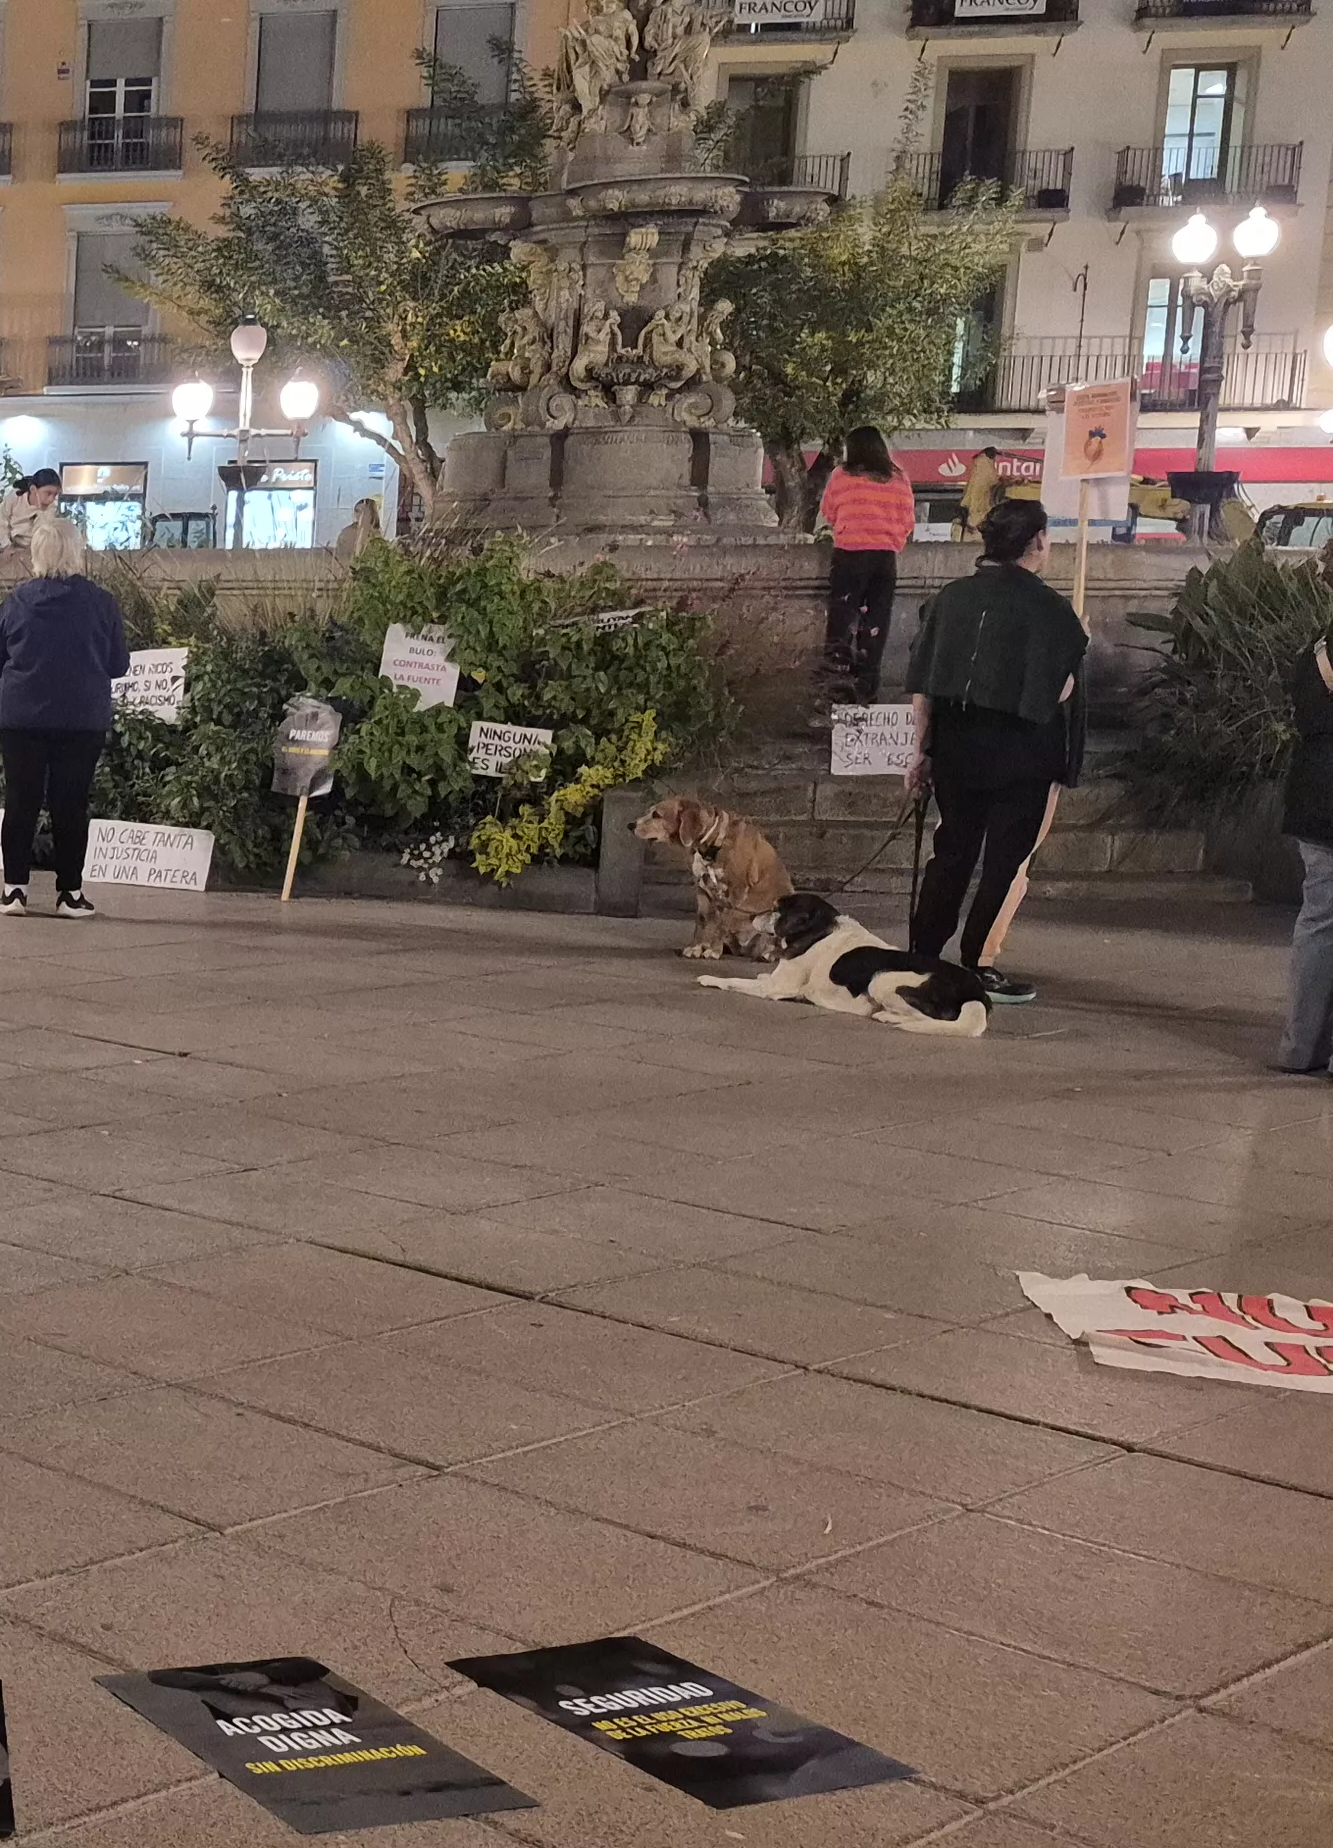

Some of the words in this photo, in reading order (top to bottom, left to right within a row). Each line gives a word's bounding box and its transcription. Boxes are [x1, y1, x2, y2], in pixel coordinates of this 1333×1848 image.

[738, 0, 819, 17] FRANCOY
[271, 467, 313, 482] Prieto
[148, 661, 174, 675] RICOS
[392, 658, 448, 673] CONTRASTA
[143, 680, 152, 692] SI
[394, 673, 405, 681] LA
[407, 674, 442, 686] FUENTE
[844, 711, 899, 728] DERECHO
[288, 728, 330, 743] PAREMOS
[471, 756, 490, 771] ES
[844, 750, 872, 769] SER
[96, 826, 116, 843] NO
[118, 828, 150, 846] CABE
[151, 831, 194, 851] TANTA
[93, 846, 158, 864] INJUSTICIA
[89, 863, 108, 878] EN
[112, 864, 139, 881] UNA
[146, 867, 198, 887] PATERA
[558, 1681, 714, 1716] SEGURIDAD
[215, 1708, 353, 1737] ACOGIDA
[591, 1719, 618, 1731] NO
[613, 1716, 637, 1728] ES
[632, 1714, 657, 1725] EL
[650, 1709, 684, 1722] USO
[678, 1699, 748, 1718] EXCESIVO
[606, 1728, 633, 1740] DE
[627, 1725, 652, 1738] LA
[700, 1714, 725, 1726] NI
[717, 1706, 768, 1723] MALOS
[256, 1727, 362, 1753] DIGNA
[677, 1724, 734, 1740] TRATOS
[245, 1761, 283, 1775] SIN
[278, 1743, 428, 1771] DISCRIMINACIÓN
